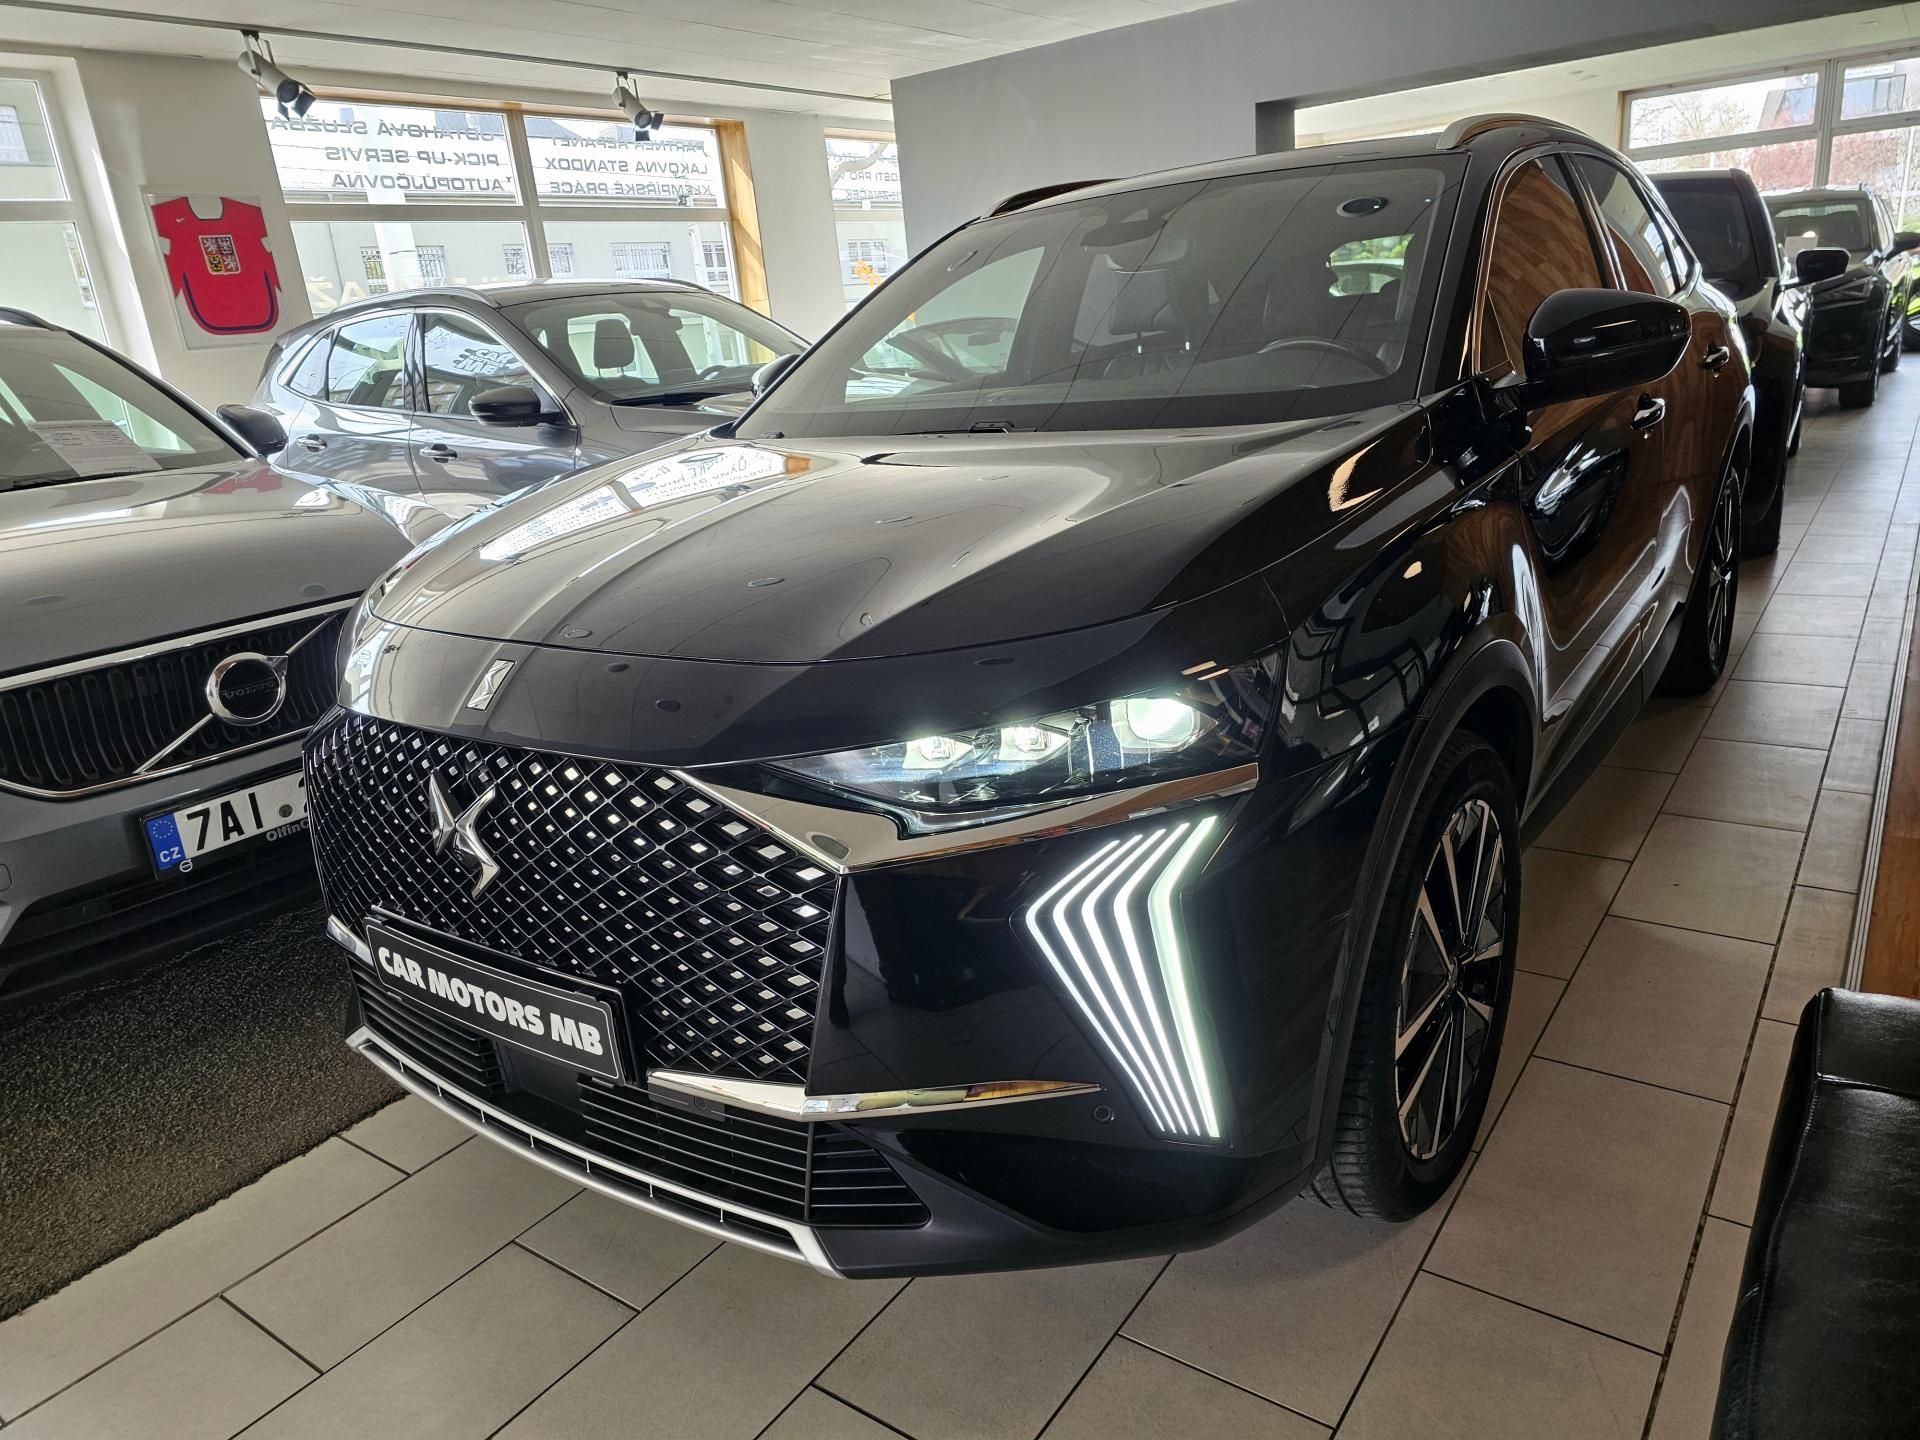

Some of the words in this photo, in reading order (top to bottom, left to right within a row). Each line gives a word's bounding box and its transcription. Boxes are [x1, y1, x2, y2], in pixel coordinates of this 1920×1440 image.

[159, 846, 182, 863] CZ
[378, 946, 426, 990] CAR
[427, 967, 545, 1036] MOTORS
[550, 1012, 603, 1056] MB
